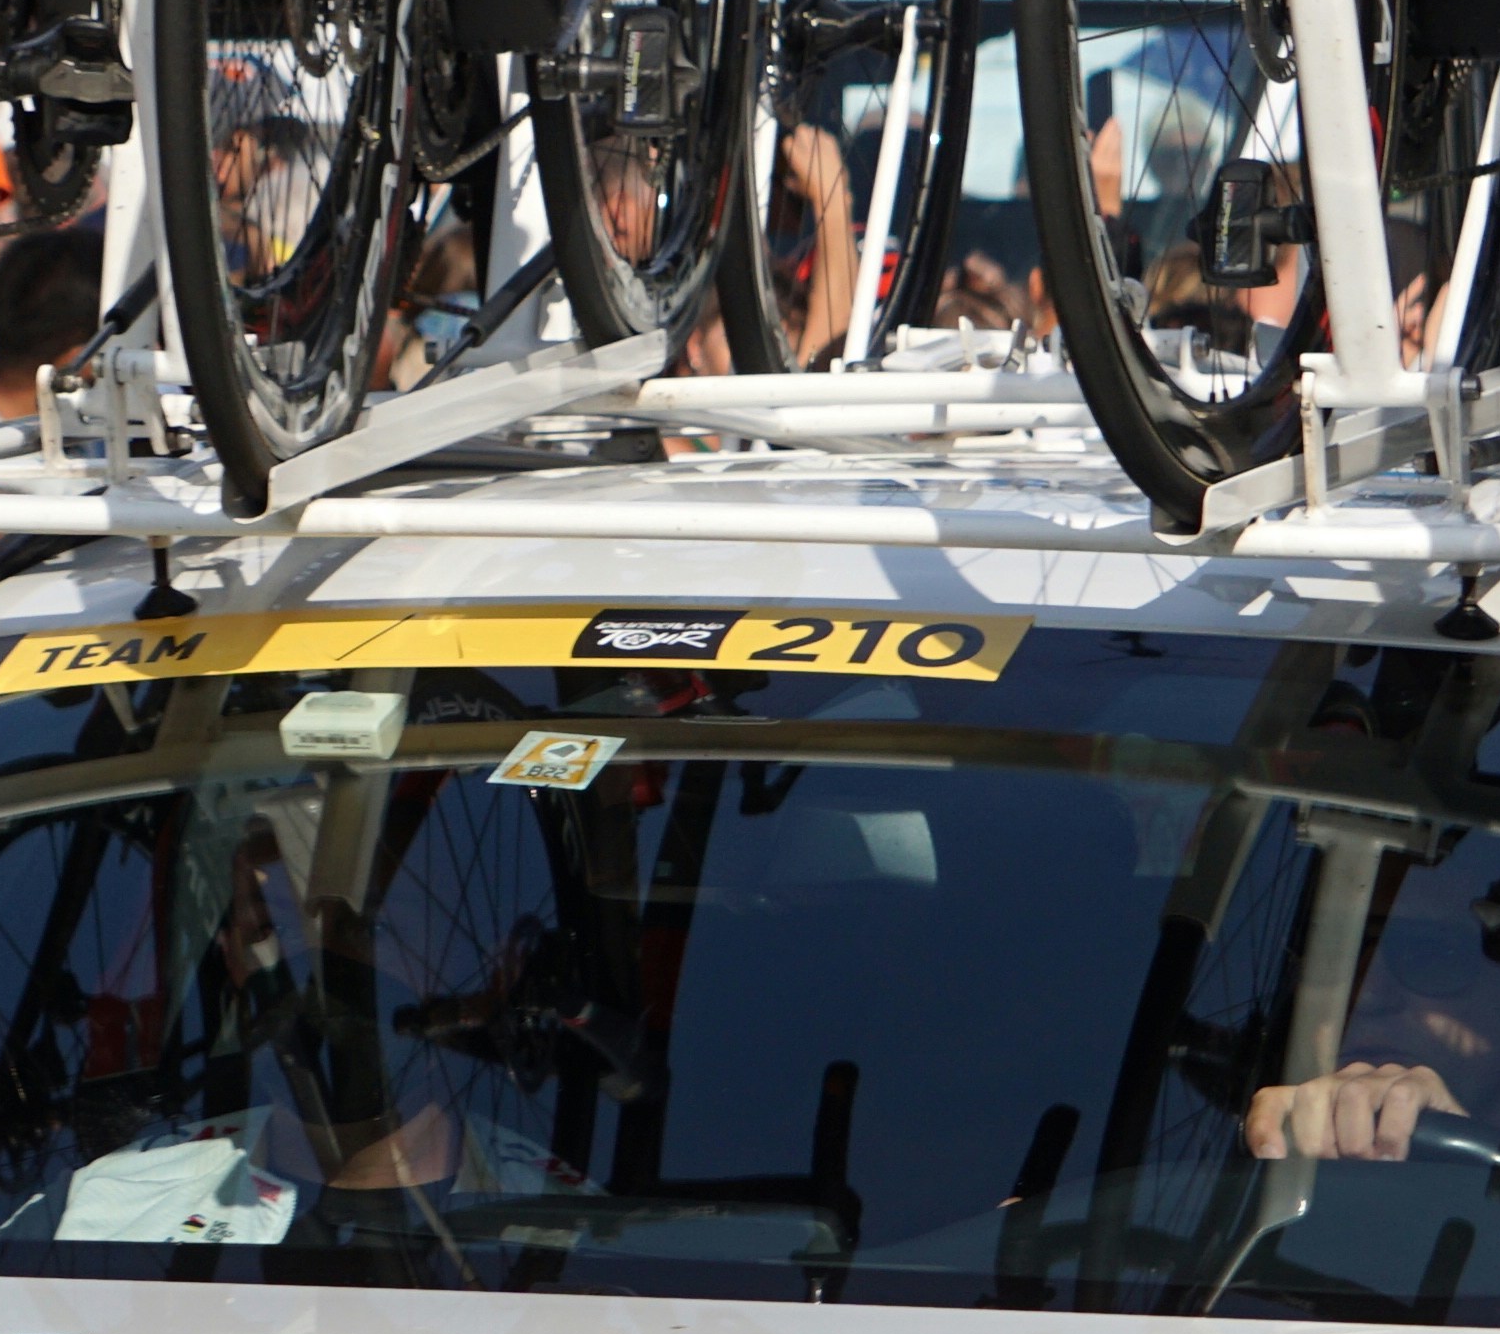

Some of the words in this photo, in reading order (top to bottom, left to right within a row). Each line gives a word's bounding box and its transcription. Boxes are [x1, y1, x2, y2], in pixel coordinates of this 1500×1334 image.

[593, 620, 727, 633] DEUTSCHLAND
[596, 627, 712, 651] TOUR
[748, 617, 986, 668] 210
[35, 631, 208, 674] TEAM
